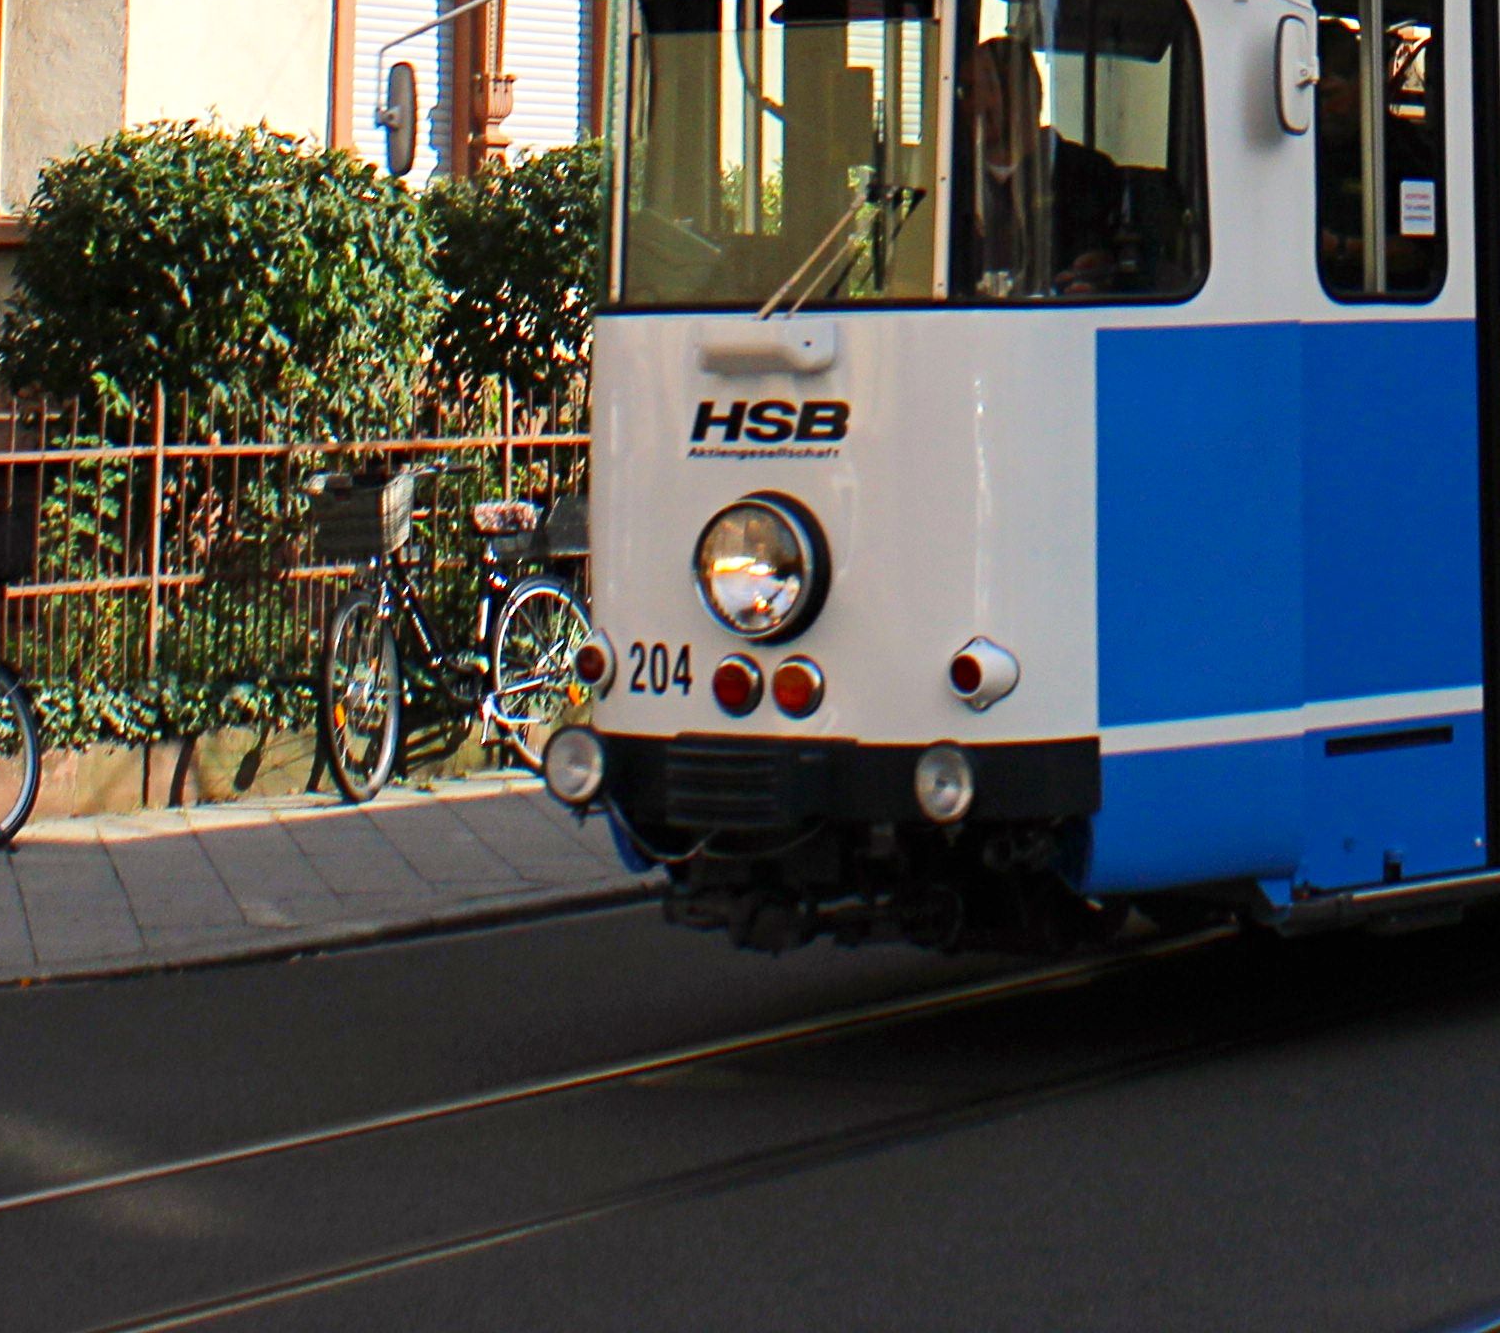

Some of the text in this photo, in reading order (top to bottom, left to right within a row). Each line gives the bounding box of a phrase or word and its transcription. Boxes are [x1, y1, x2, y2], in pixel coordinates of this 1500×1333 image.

[690, 398, 852, 444] HSB
[687, 446, 842, 461] Aktiengesellschaft
[628, 640, 694, 697] 204
